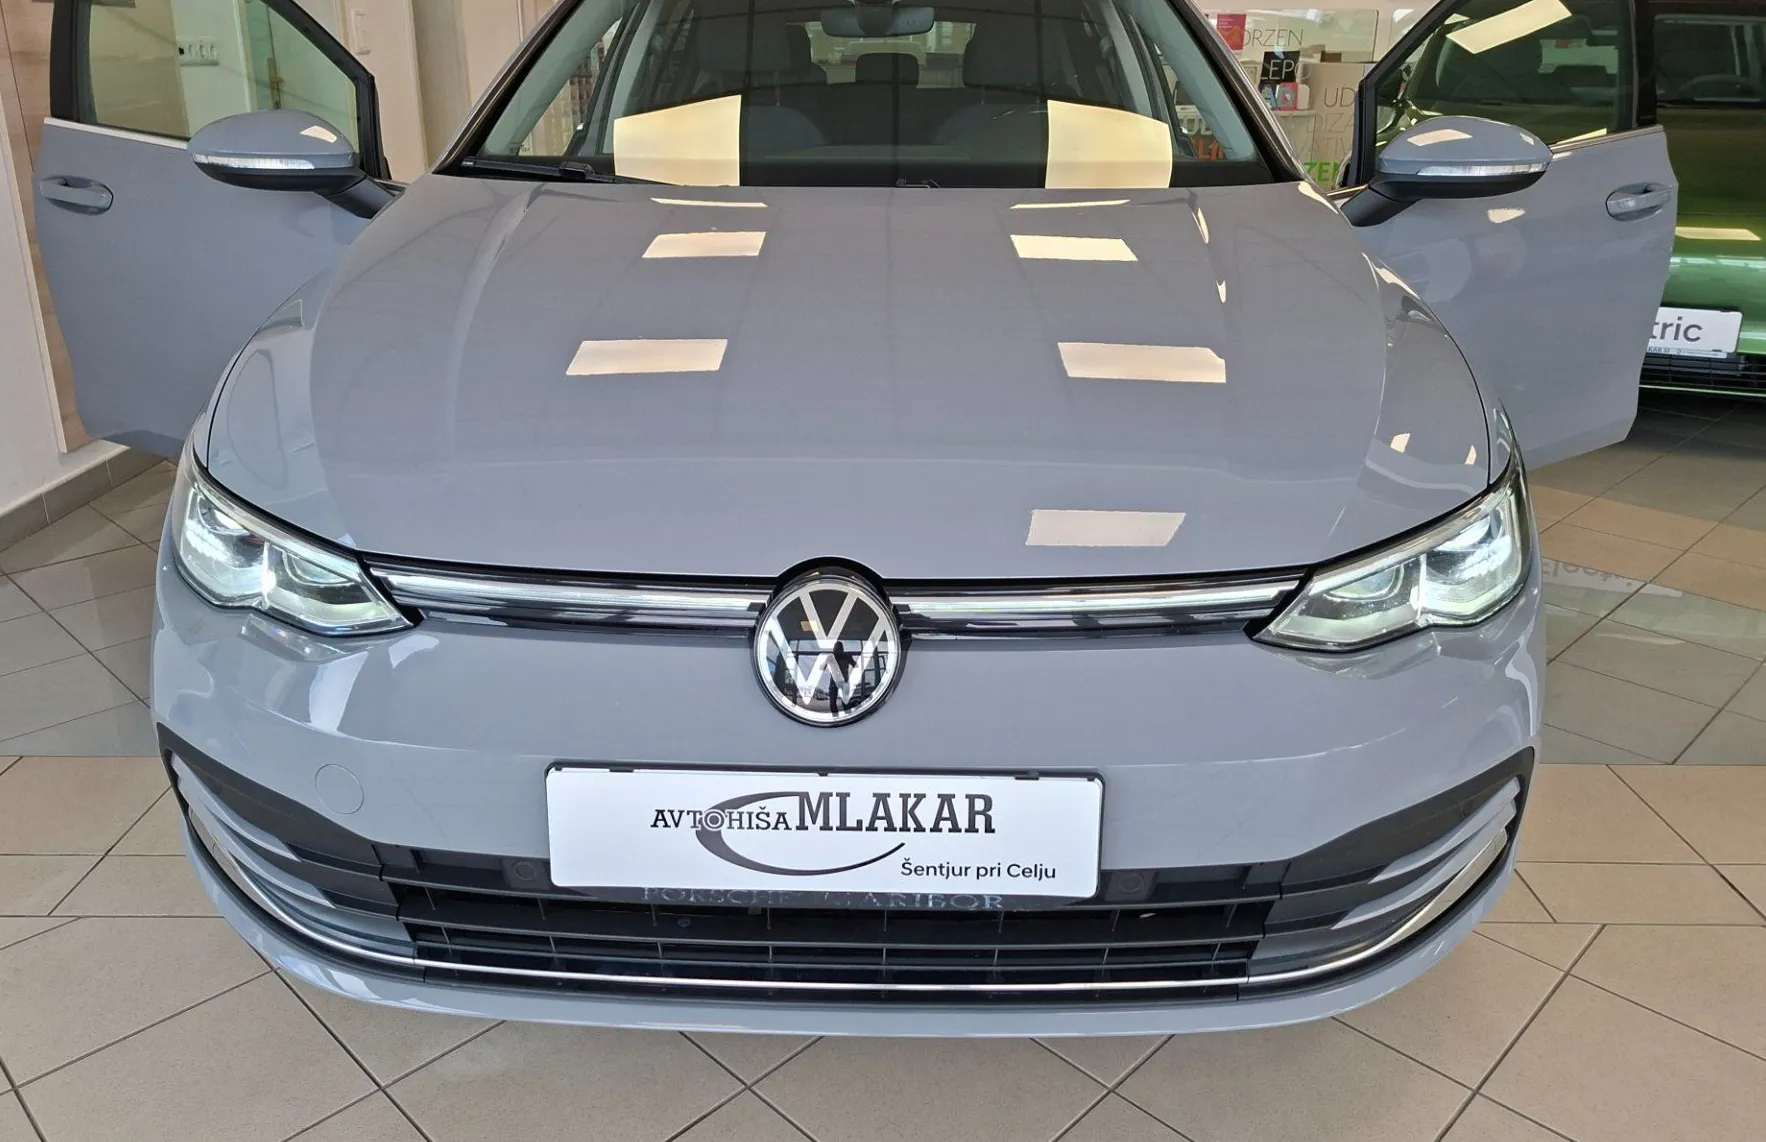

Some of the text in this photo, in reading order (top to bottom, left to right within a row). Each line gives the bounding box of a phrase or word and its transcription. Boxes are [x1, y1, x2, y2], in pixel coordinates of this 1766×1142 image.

[650, 790, 997, 835] AVTOHIŠA MLAKAR
[900, 857, 1057, 882] Šentjur pri Celju
